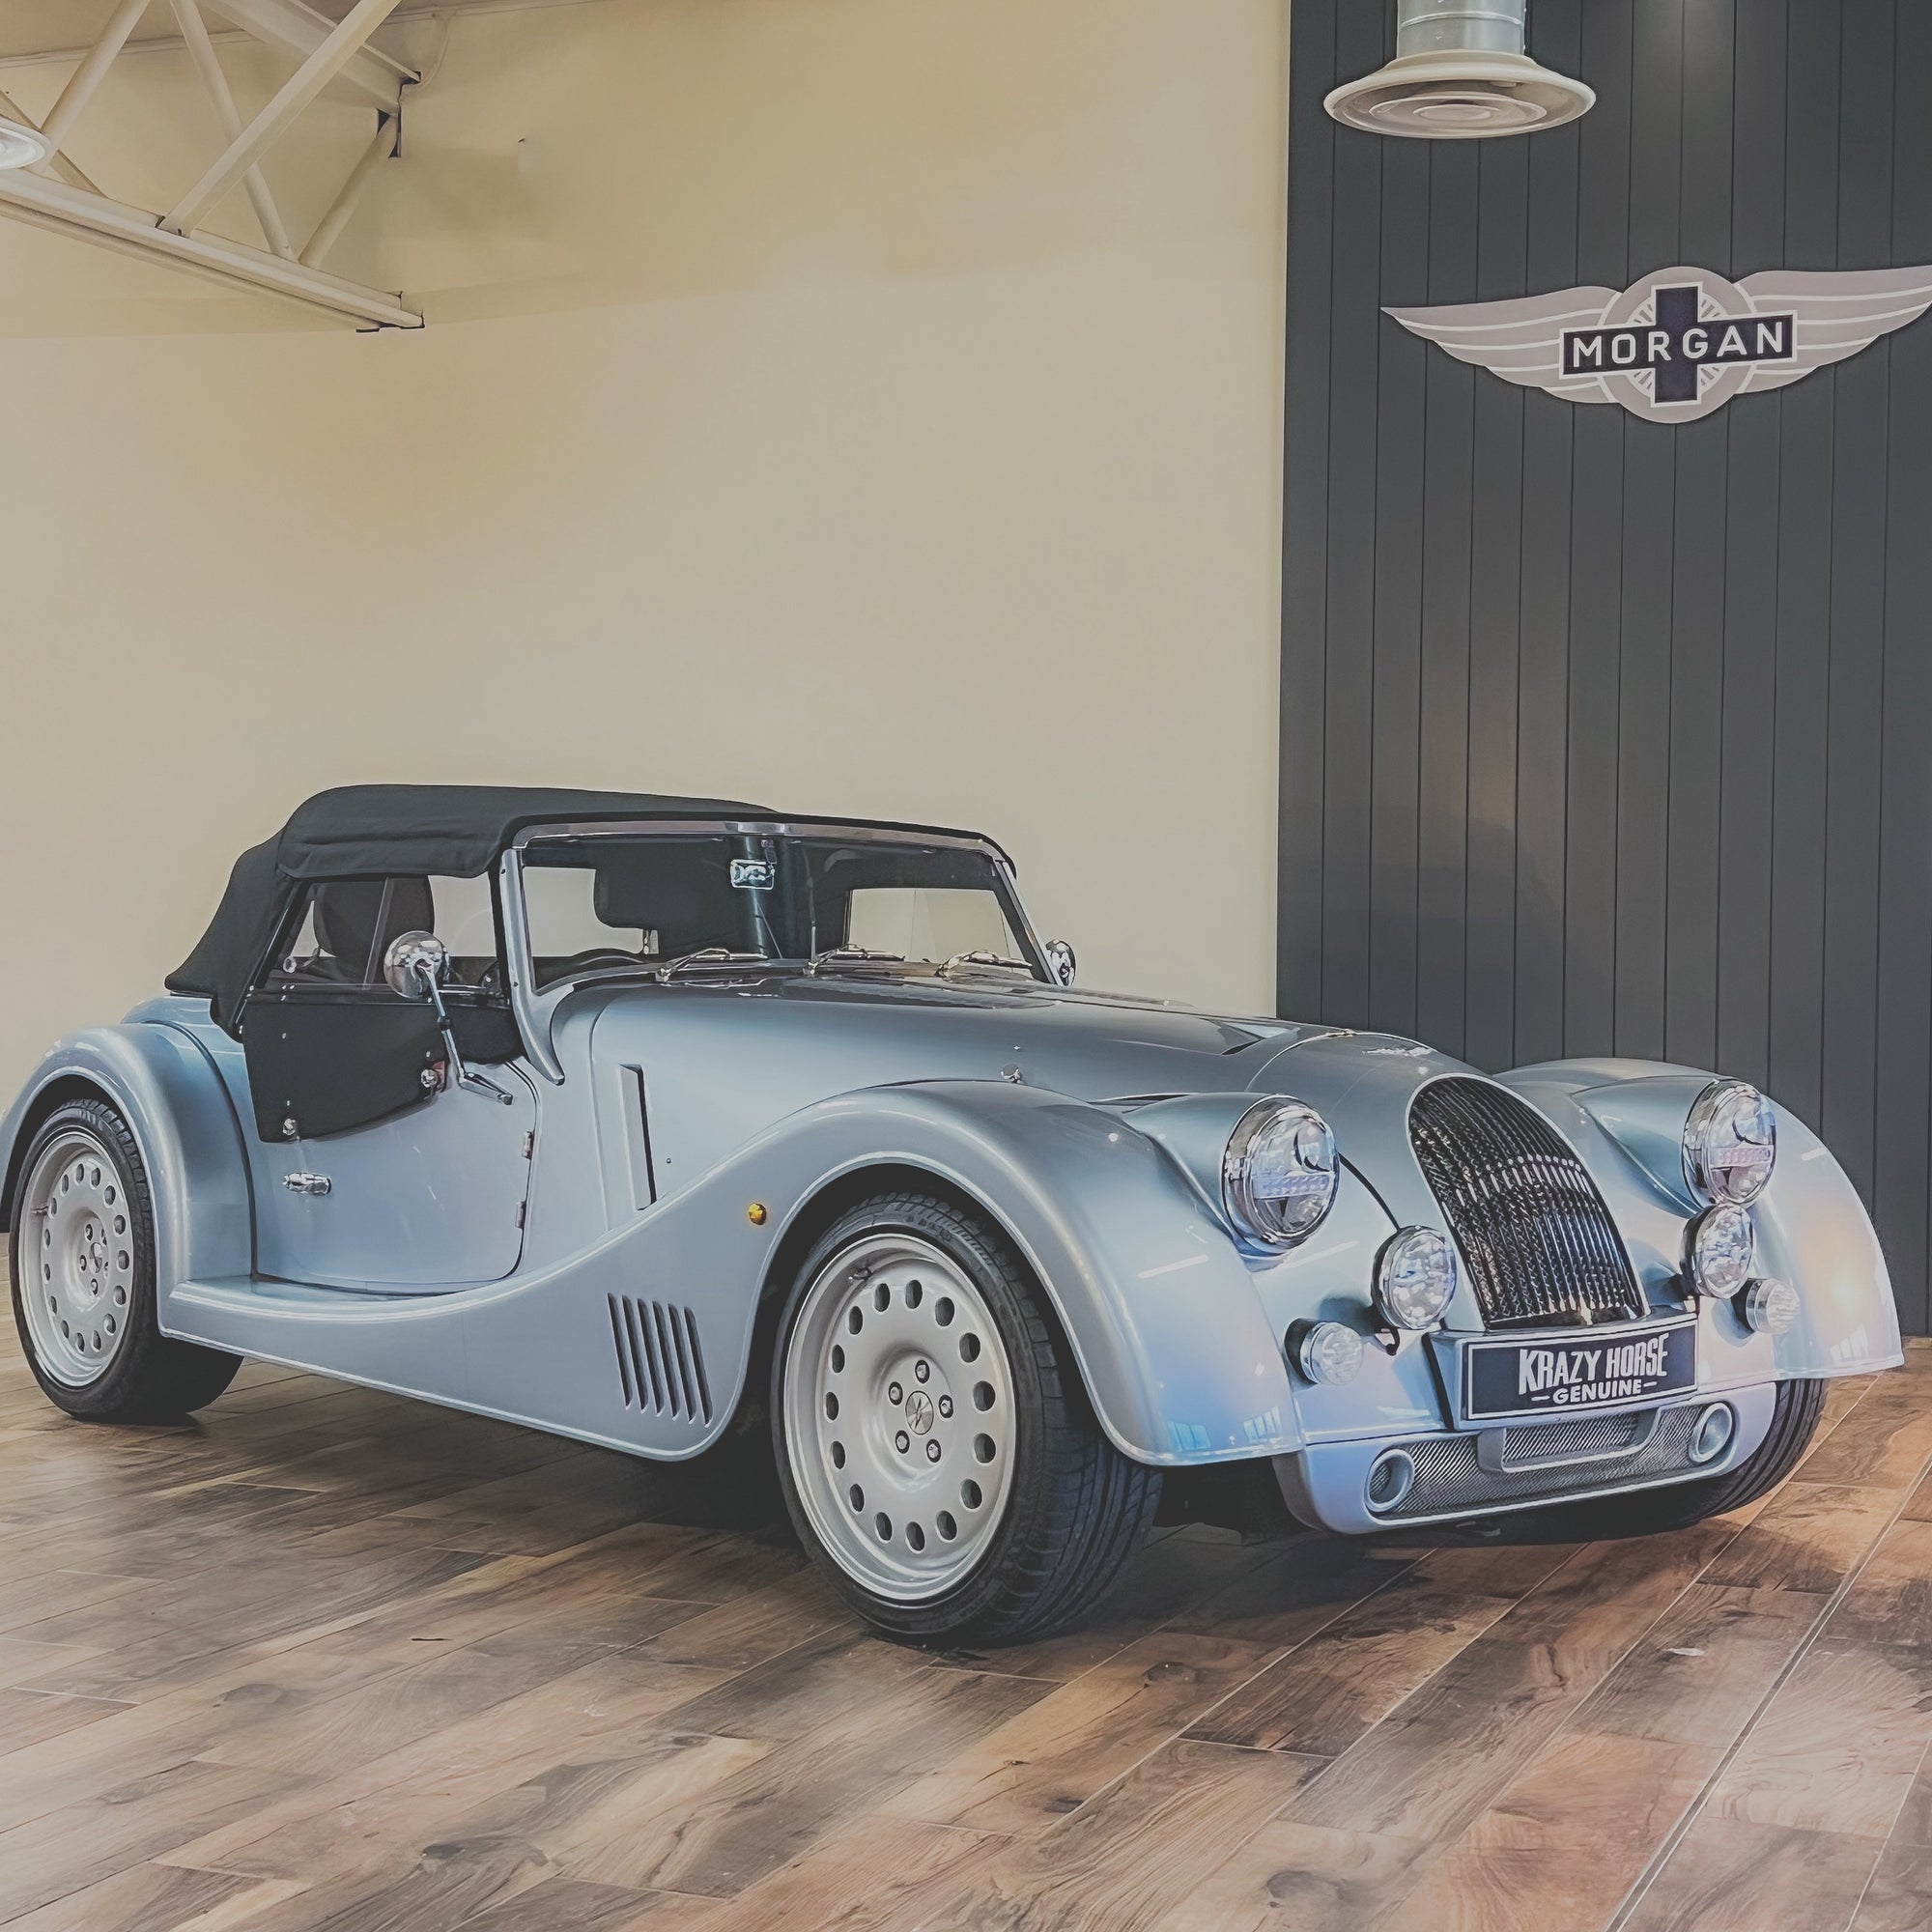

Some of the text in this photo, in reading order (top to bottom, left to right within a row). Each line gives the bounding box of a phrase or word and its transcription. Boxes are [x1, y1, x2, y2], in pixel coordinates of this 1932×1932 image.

[1572, 321, 1783, 368] MORGAN
[1519, 1332, 1669, 1395] KRAZY HORSE
[1552, 1378, 1643, 1405] GENUINE
